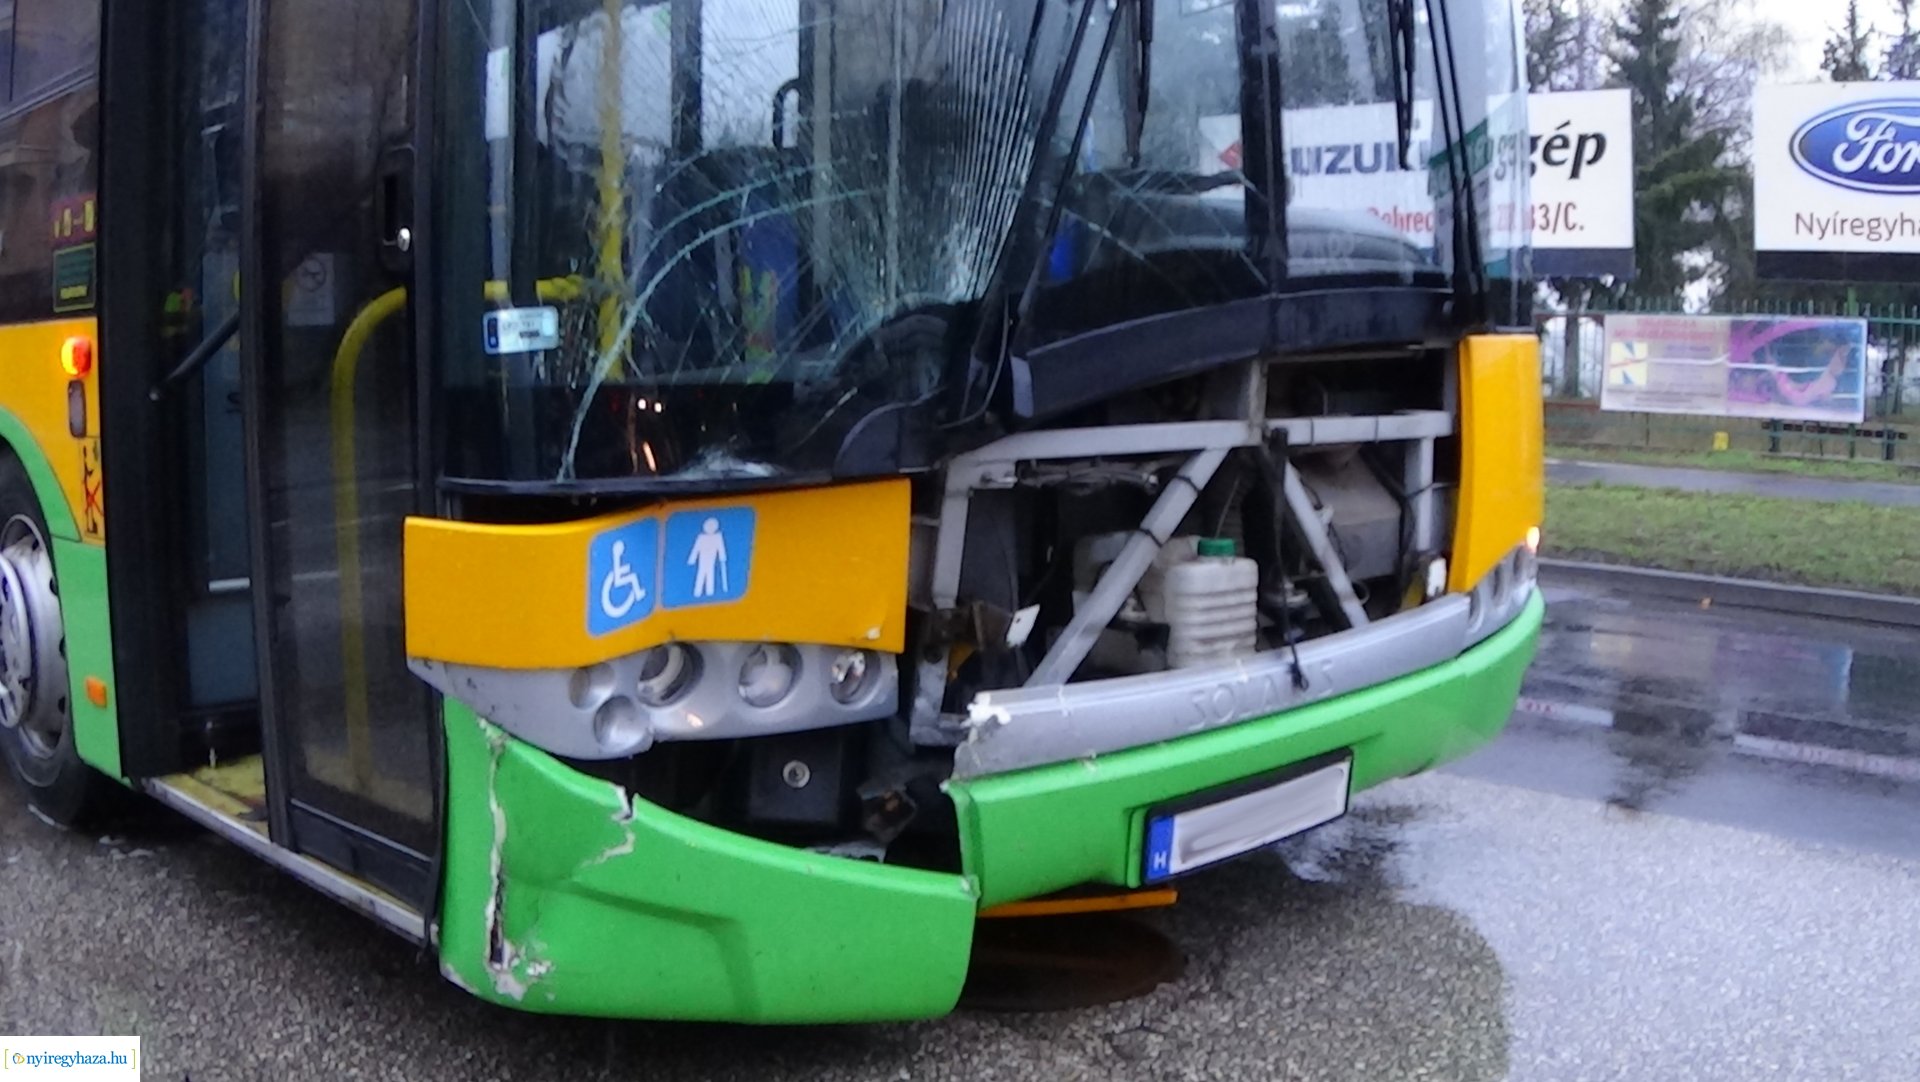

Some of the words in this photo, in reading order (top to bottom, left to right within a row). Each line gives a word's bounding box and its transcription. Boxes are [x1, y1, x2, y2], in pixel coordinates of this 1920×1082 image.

[1832, 112, 1920, 174] For
[1795, 211, 1920, 242] Nyíregyh
[1153, 851, 1169, 870] H
